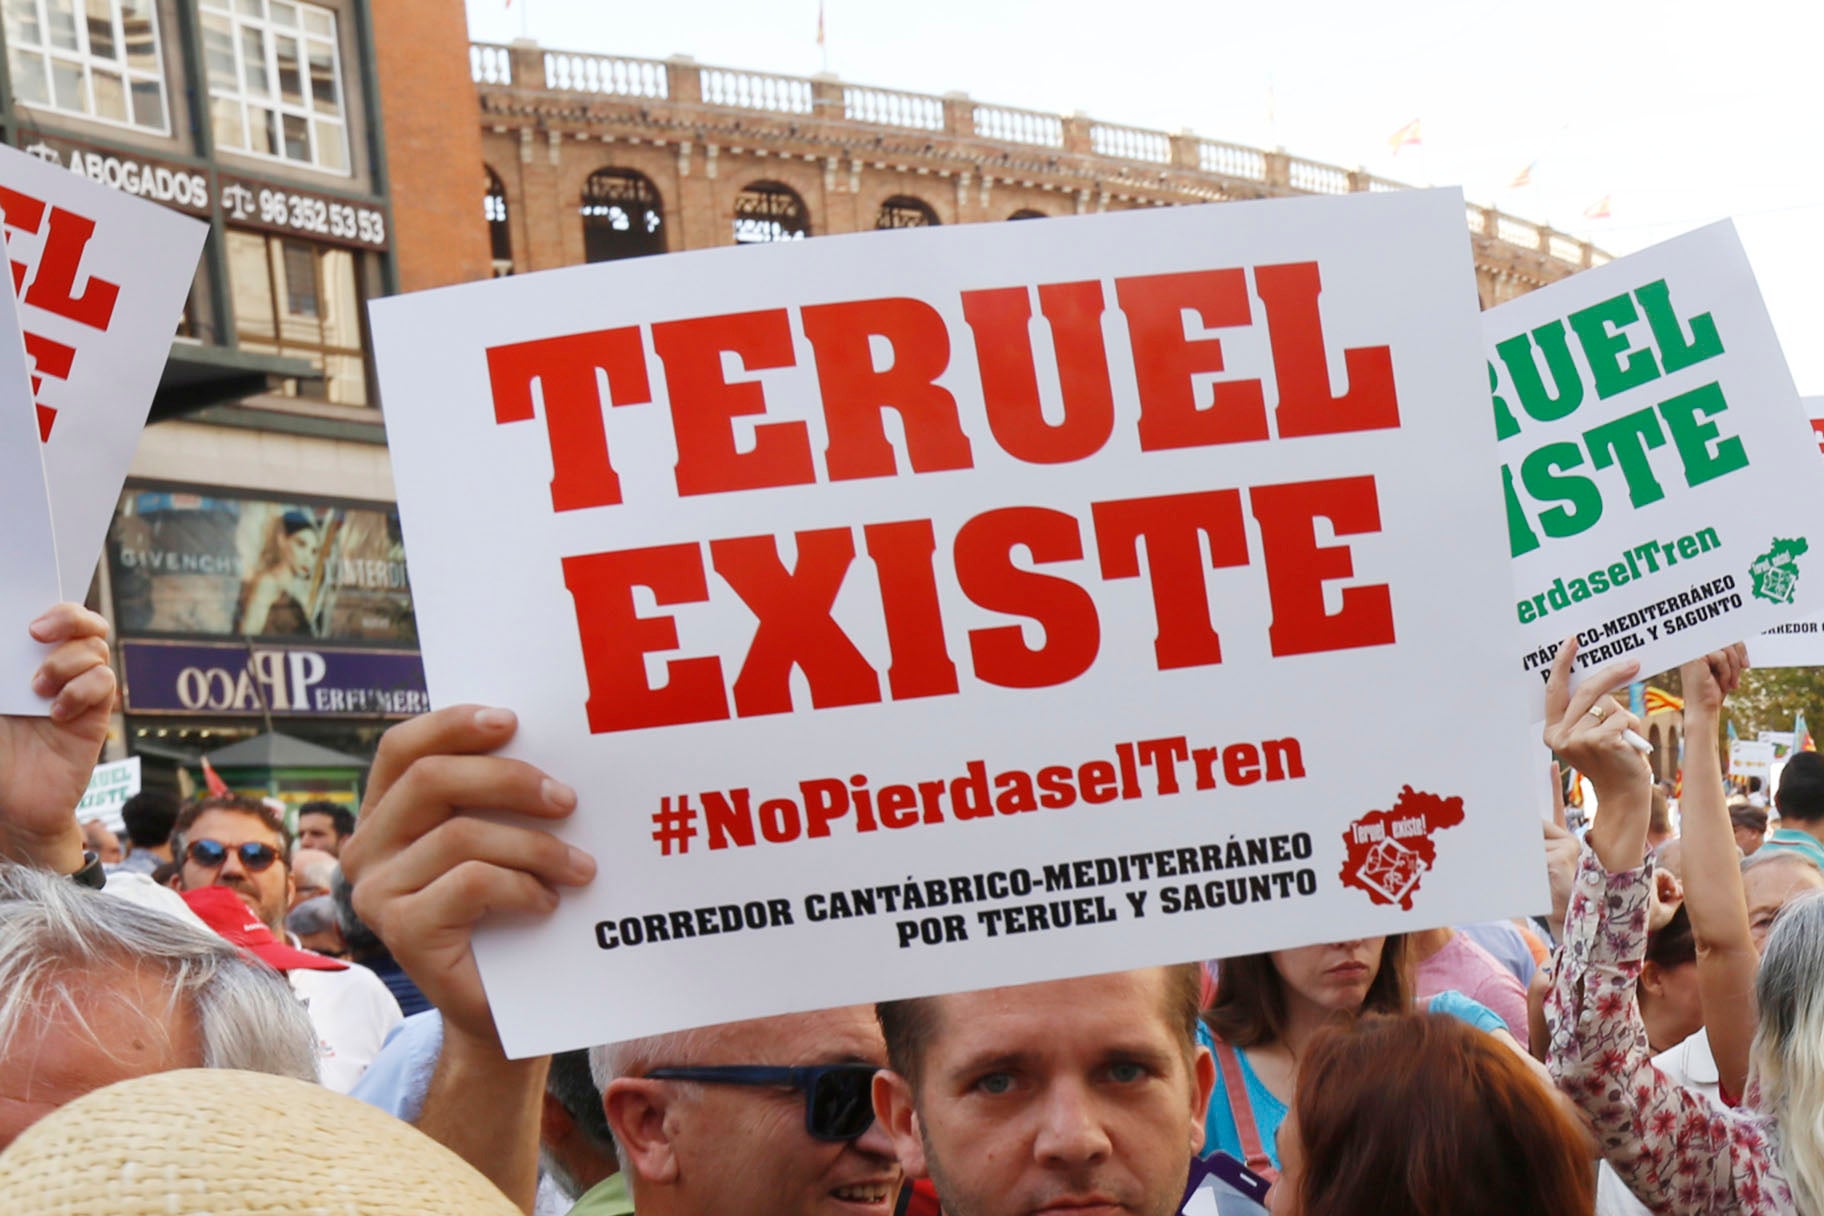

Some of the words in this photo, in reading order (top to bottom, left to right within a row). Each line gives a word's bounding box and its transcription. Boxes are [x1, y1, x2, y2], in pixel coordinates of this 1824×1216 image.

[69, 150, 208, 209] ABOGADOS
[260, 190, 286, 225] 96
[289, 198, 329, 234] 352
[329, 209, 357, 239] 53
[357, 210, 385, 245] 53
[486, 261, 1401, 513] TERUEL
[561, 475, 1396, 735] EXISTE
[1577, 634, 1645, 670] TERUEL
[1646, 626, 1659, 641] Y
[1665, 593, 1743, 635] SAGUNTO
[652, 735, 1306, 856] #NoPierdaselTren
[595, 897, 794, 952] CORREDOR
[804, 831, 1314, 923] CANTÁBRICO-MEDITERRÁNEO
[896, 913, 969, 949] POR
[978, 894, 1117, 941] TERUEL
[1126, 890, 1149, 920] Y
[1161, 869, 1317, 916] SAGUNTO
